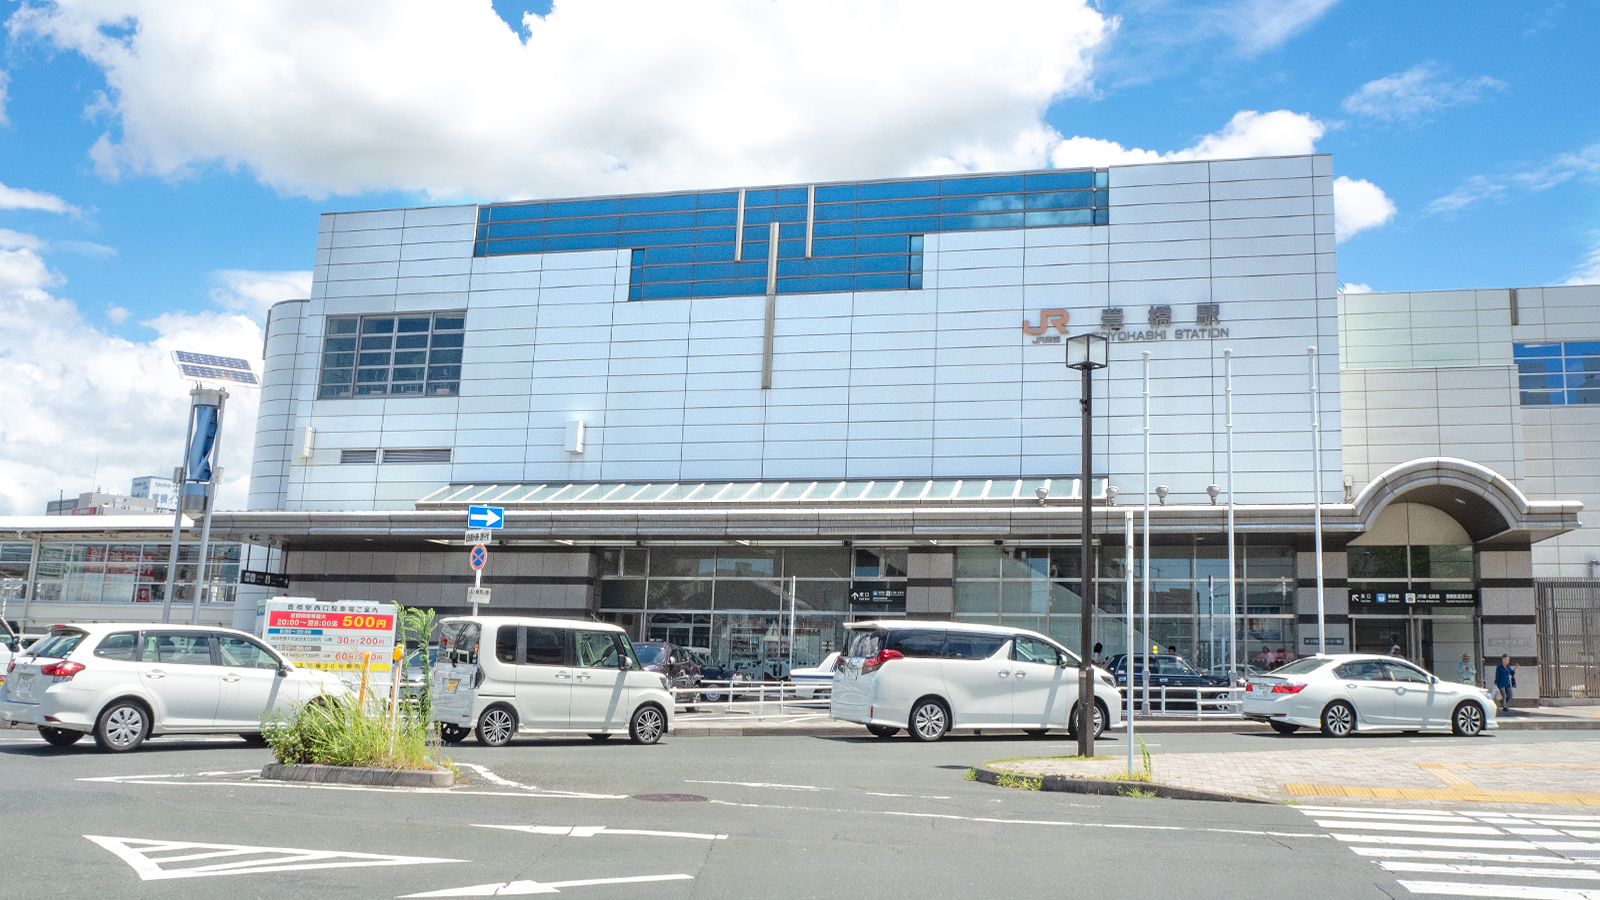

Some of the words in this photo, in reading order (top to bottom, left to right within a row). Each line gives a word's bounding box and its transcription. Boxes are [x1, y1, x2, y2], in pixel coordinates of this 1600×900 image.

[1023, 309, 1070, 336] JR
[1100, 304, 1220, 330] 豊橋駅
[1091, 331, 1167, 342] YOHASHI
[1174, 328, 1230, 339] STATION
[342, 615, 387, 629] 500円
[336, 636, 385, 645] 30分/200円
[335, 652, 383, 661] 60分/20円
